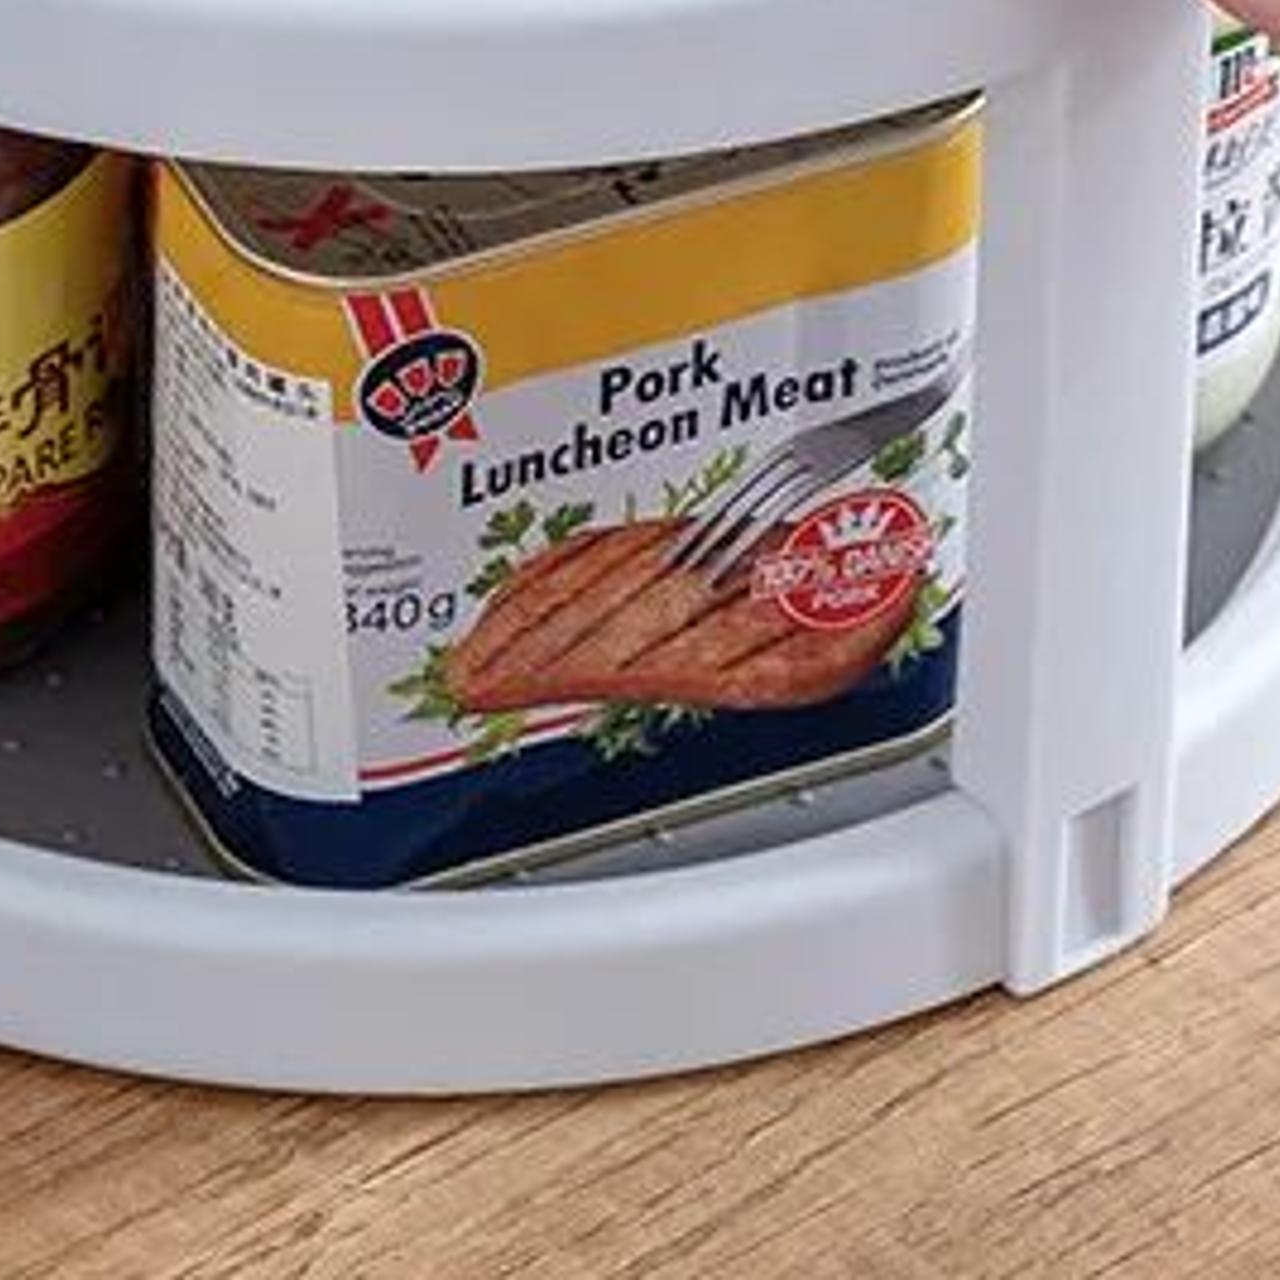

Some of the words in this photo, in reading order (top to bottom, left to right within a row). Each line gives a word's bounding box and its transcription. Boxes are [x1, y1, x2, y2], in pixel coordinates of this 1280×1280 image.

[460, 406, 700, 507] Luncheon
[719, 357, 860, 433] Meat
[599, 340, 722, 416] Pork
